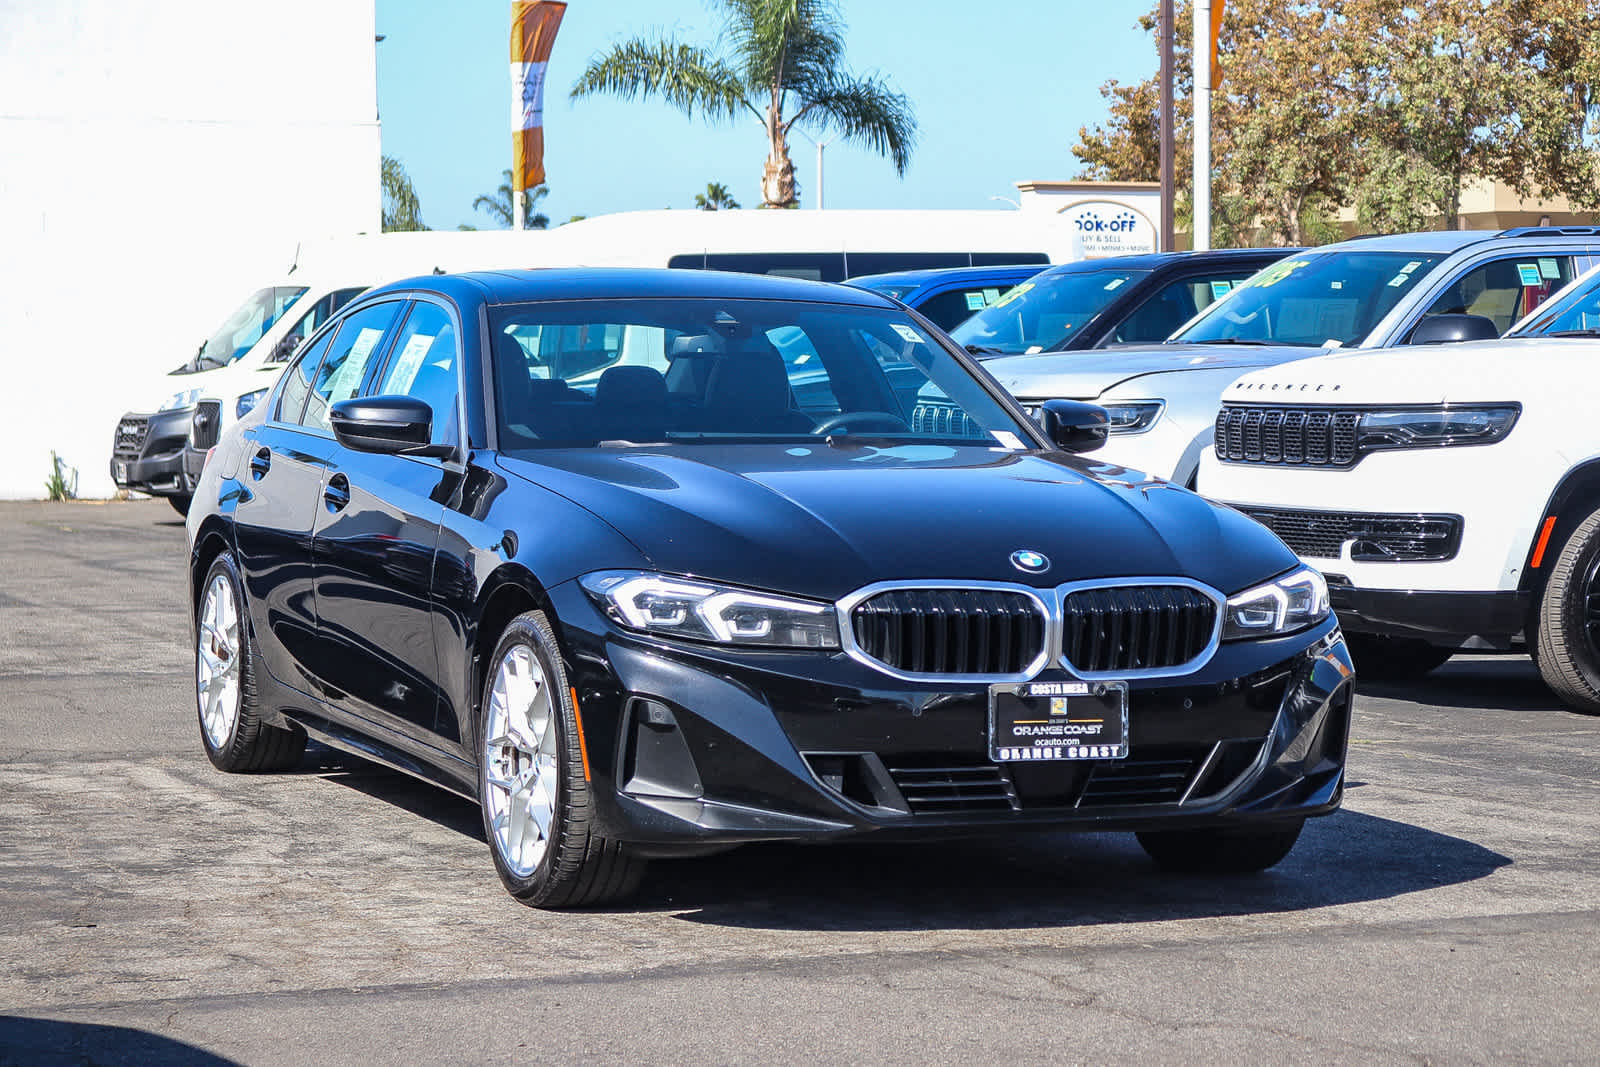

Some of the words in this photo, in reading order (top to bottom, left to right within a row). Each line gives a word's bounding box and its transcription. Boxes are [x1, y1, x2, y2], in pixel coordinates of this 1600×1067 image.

[1104, 235, 1121, 243] SELL
[1031, 684, 1061, 694] COSTA
[1063, 683, 1089, 694] MESA
[1013, 725, 1063, 736] ORANGE
[1064, 724, 1104, 735] COAST
[1035, 737, 1080, 746] ocauto.com
[1000, 748, 1062, 760] ORANGE
[1068, 746, 1120, 758] COAST
